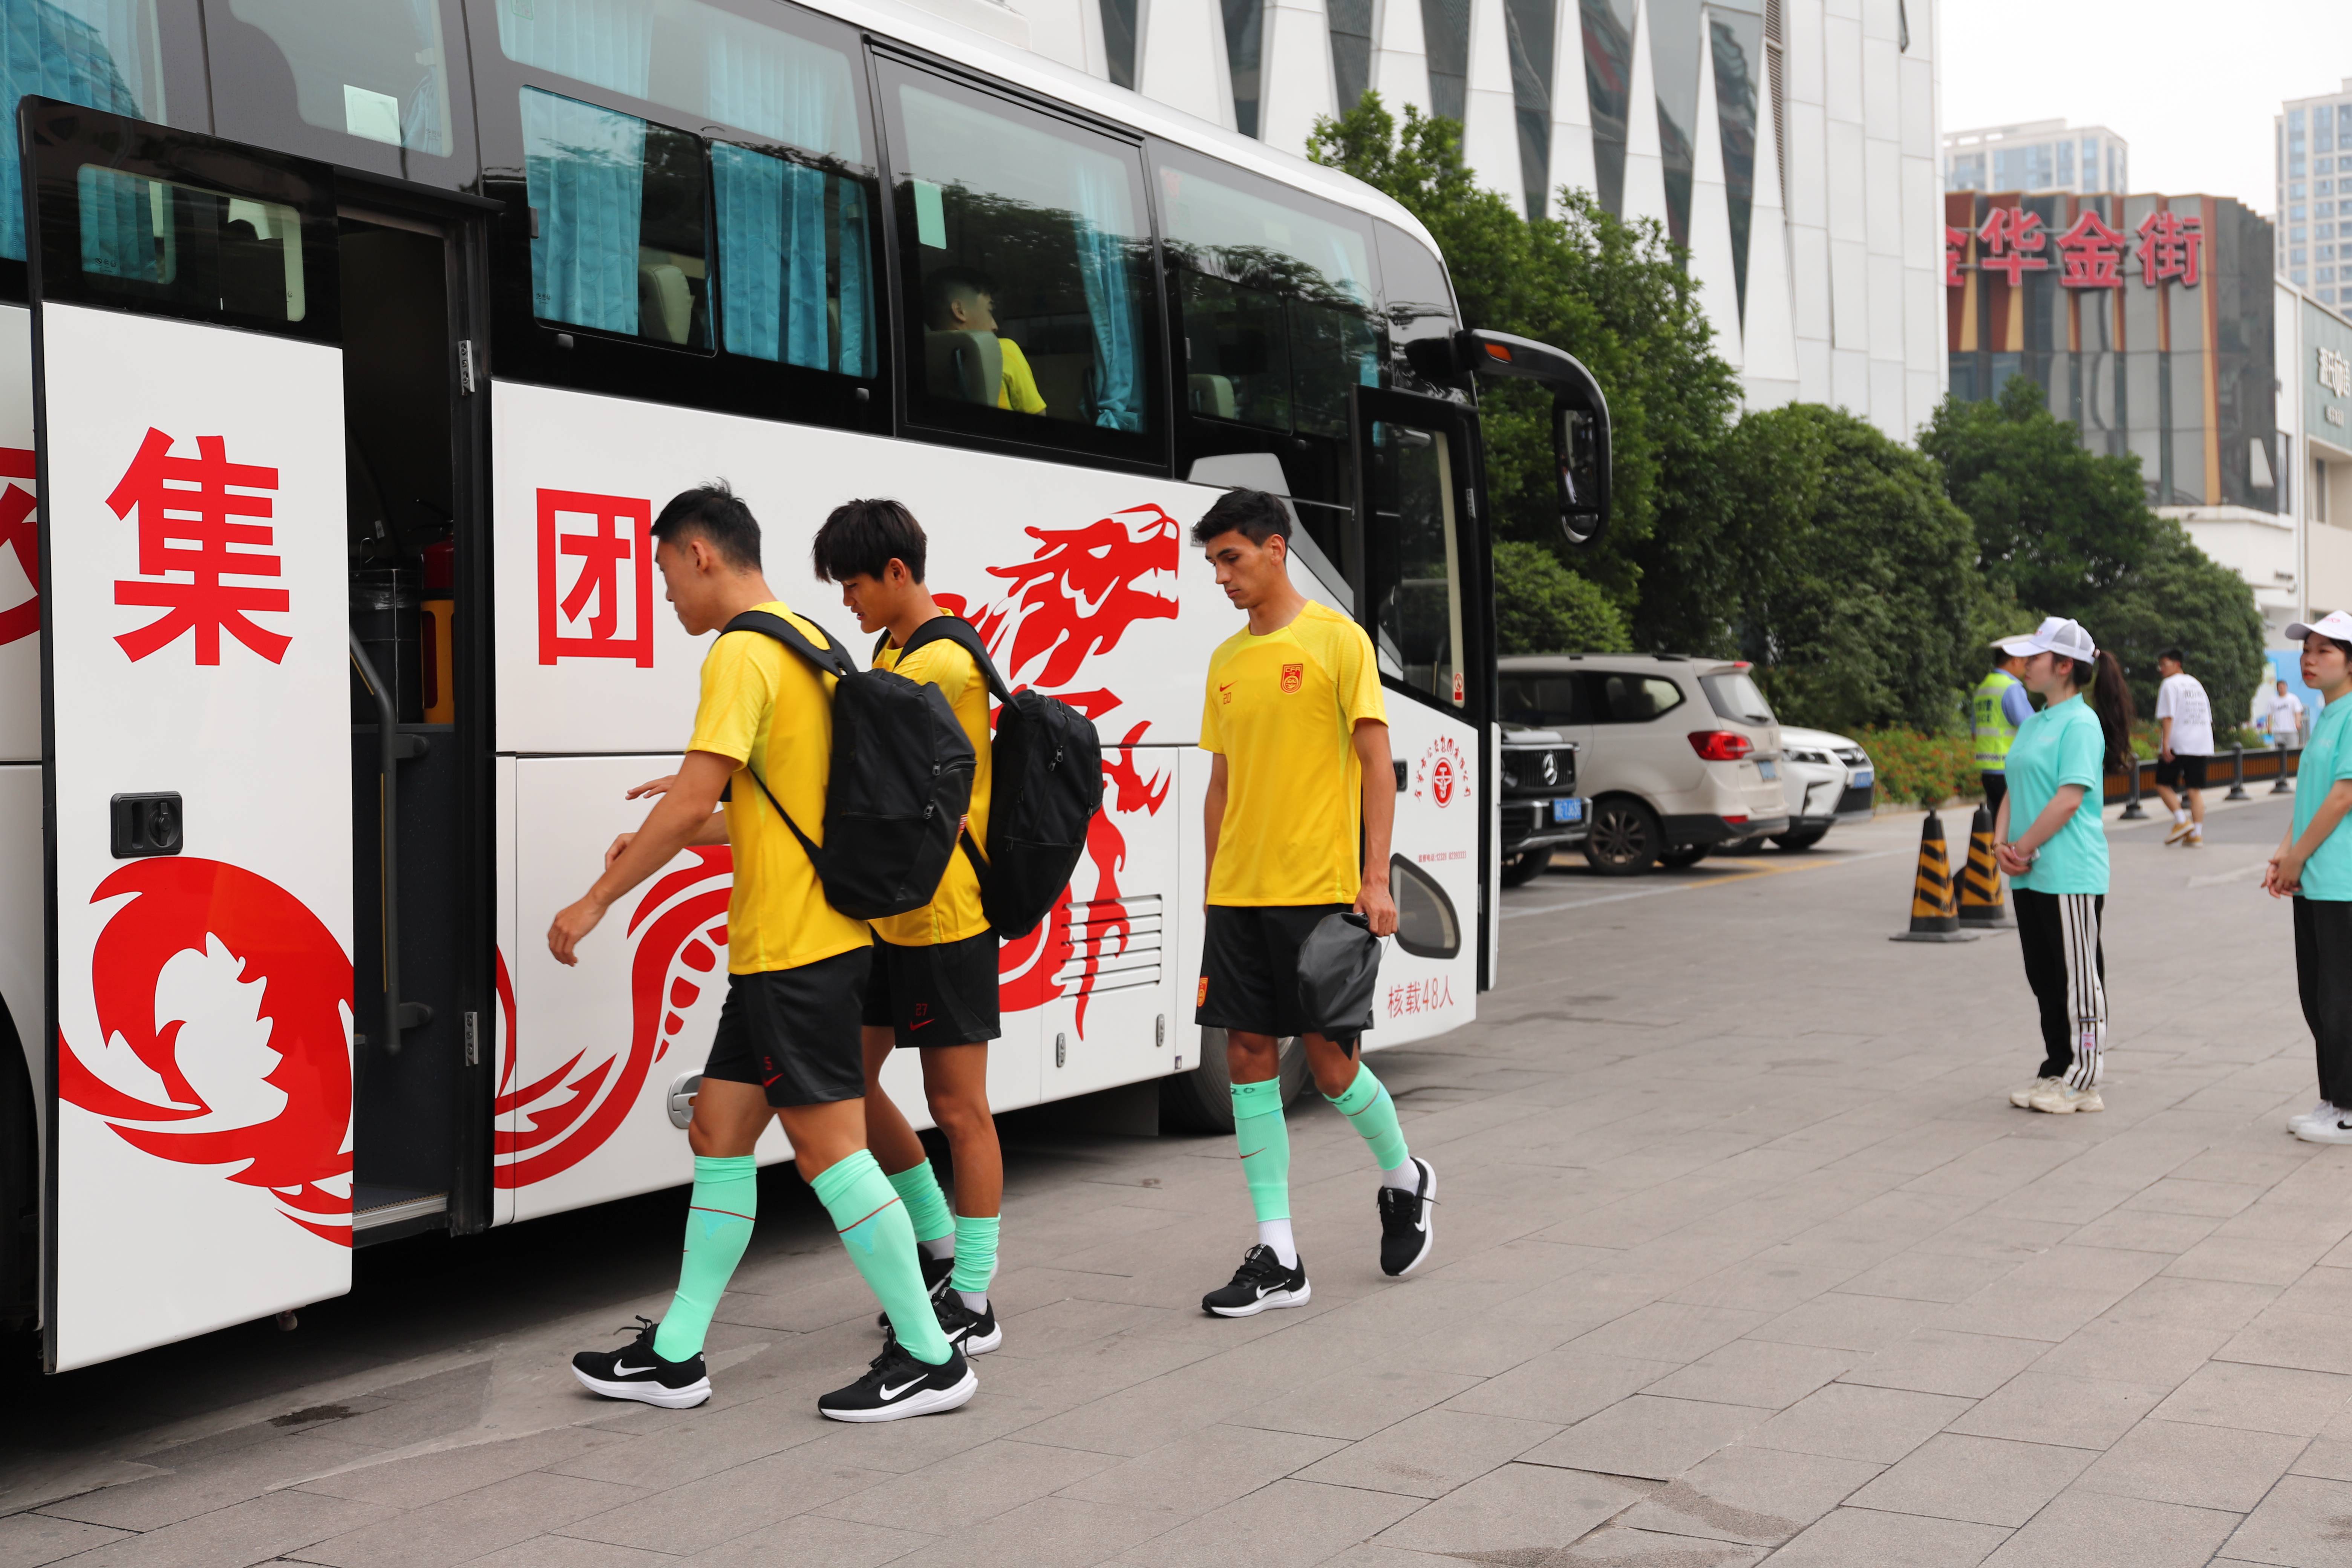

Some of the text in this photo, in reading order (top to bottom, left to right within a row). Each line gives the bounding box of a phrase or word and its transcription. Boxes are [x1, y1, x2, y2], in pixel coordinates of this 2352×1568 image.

[105, 426, 293, 666] 集
[536, 488, 654, 668] 团
[1223, 692, 1232, 704] 20
[1387, 975, 1454, 1019] 核载48人
[916, 1003, 928, 1017] 27
[763, 1056, 773, 1071] 5
